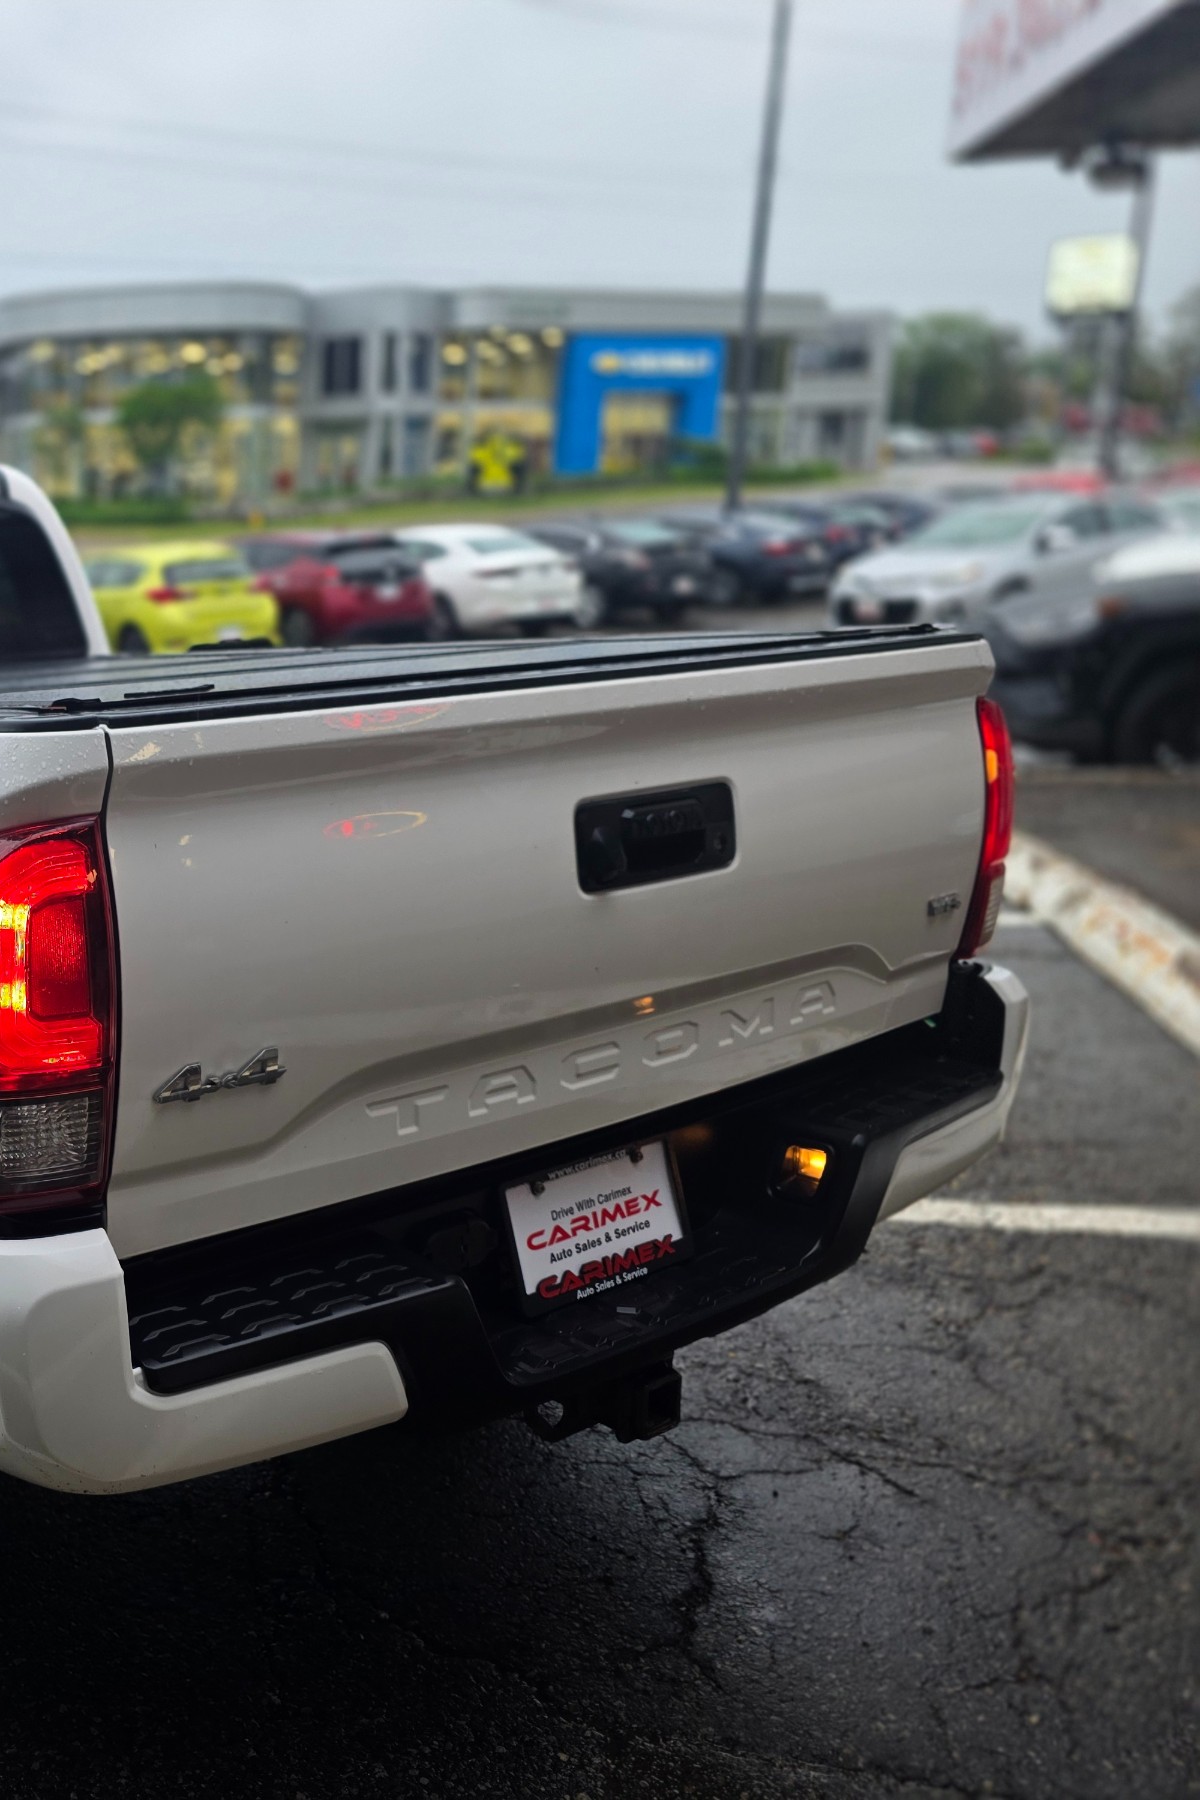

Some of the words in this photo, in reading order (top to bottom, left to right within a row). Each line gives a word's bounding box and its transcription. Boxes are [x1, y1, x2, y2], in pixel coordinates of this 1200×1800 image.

[365, 980, 836, 1136] TACOMA
[526, 1189, 662, 1250] CARIMEX
[551, 1205, 575, 1222] Drive
[575, 1197, 596, 1215] With
[597, 1186, 632, 1205] Carimex
[536, 1233, 676, 1299] CARIMEX
[550, 1247, 573, 1264] Auto
[575, 1237, 603, 1254] Sales
[604, 1231, 612, 1242] &
[614, 1219, 651, 1239] Service
[576, 1284, 595, 1300] Auto
[595, 1279, 615, 1293] Sales
[615, 1275, 622, 1285] &
[622, 1266, 648, 1283] Service
